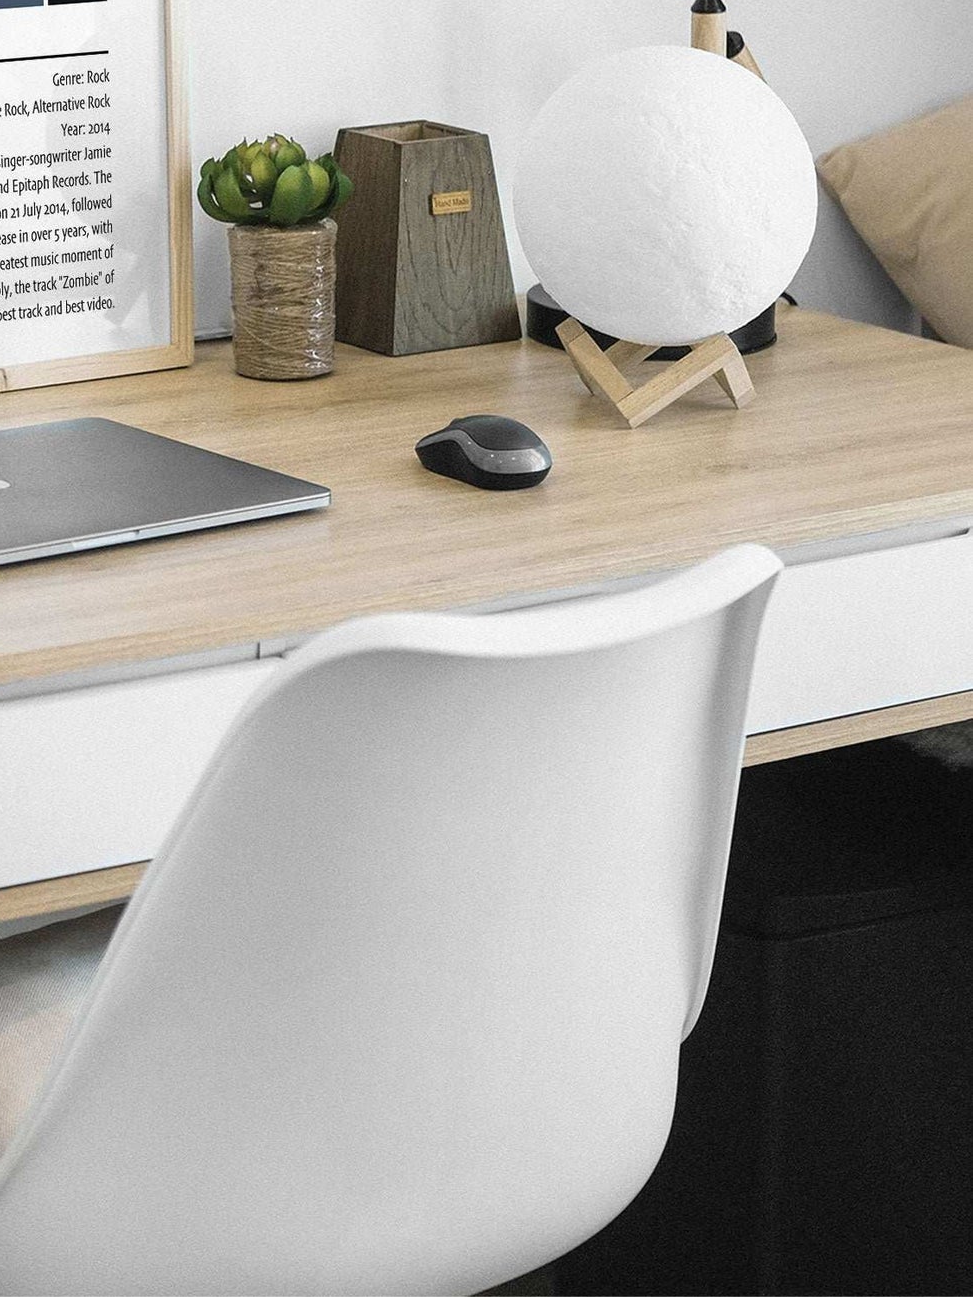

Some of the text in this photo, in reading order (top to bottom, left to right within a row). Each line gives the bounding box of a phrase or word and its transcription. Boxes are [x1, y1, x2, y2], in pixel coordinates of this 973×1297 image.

[52, 68, 110, 86] Genre: Rock
[4, 100, 30, 117] Rock,
[32, 97, 85, 114] Alternative
[88, 93, 111, 109] Rock
[61, 122, 110, 136] Year: 2014
[84, 145, 112, 160] Jamie
[12, 175, 49, 196] Epitaph
[52, 171, 91, 189] Records.
[93, 170, 112, 184] The
[10, 207, 20, 218] 21
[22, 202, 42, 219] July
[44, 203, 69, 216] 2014,
[71, 194, 112, 212] followed
[19, 229, 28, 243] in
[31, 229, 52, 242] over
[54, 229, 60, 242] 5
[62, 226, 89, 242] years,
[91, 219, 113, 235] with
[31, 251, 59, 267] music
[61, 247, 102, 264] moment
[104, 244, 114, 259] of
[14, 280, 31, 294] the
[33, 276, 57, 292] track
[59, 271, 102, 289] "Zombie"
[105, 269, 115, 284] of
[18, 303, 43, 319] track
[44, 300, 62, 316] and
[65, 300, 85, 314] best
[87, 296, 115, 311] video.
